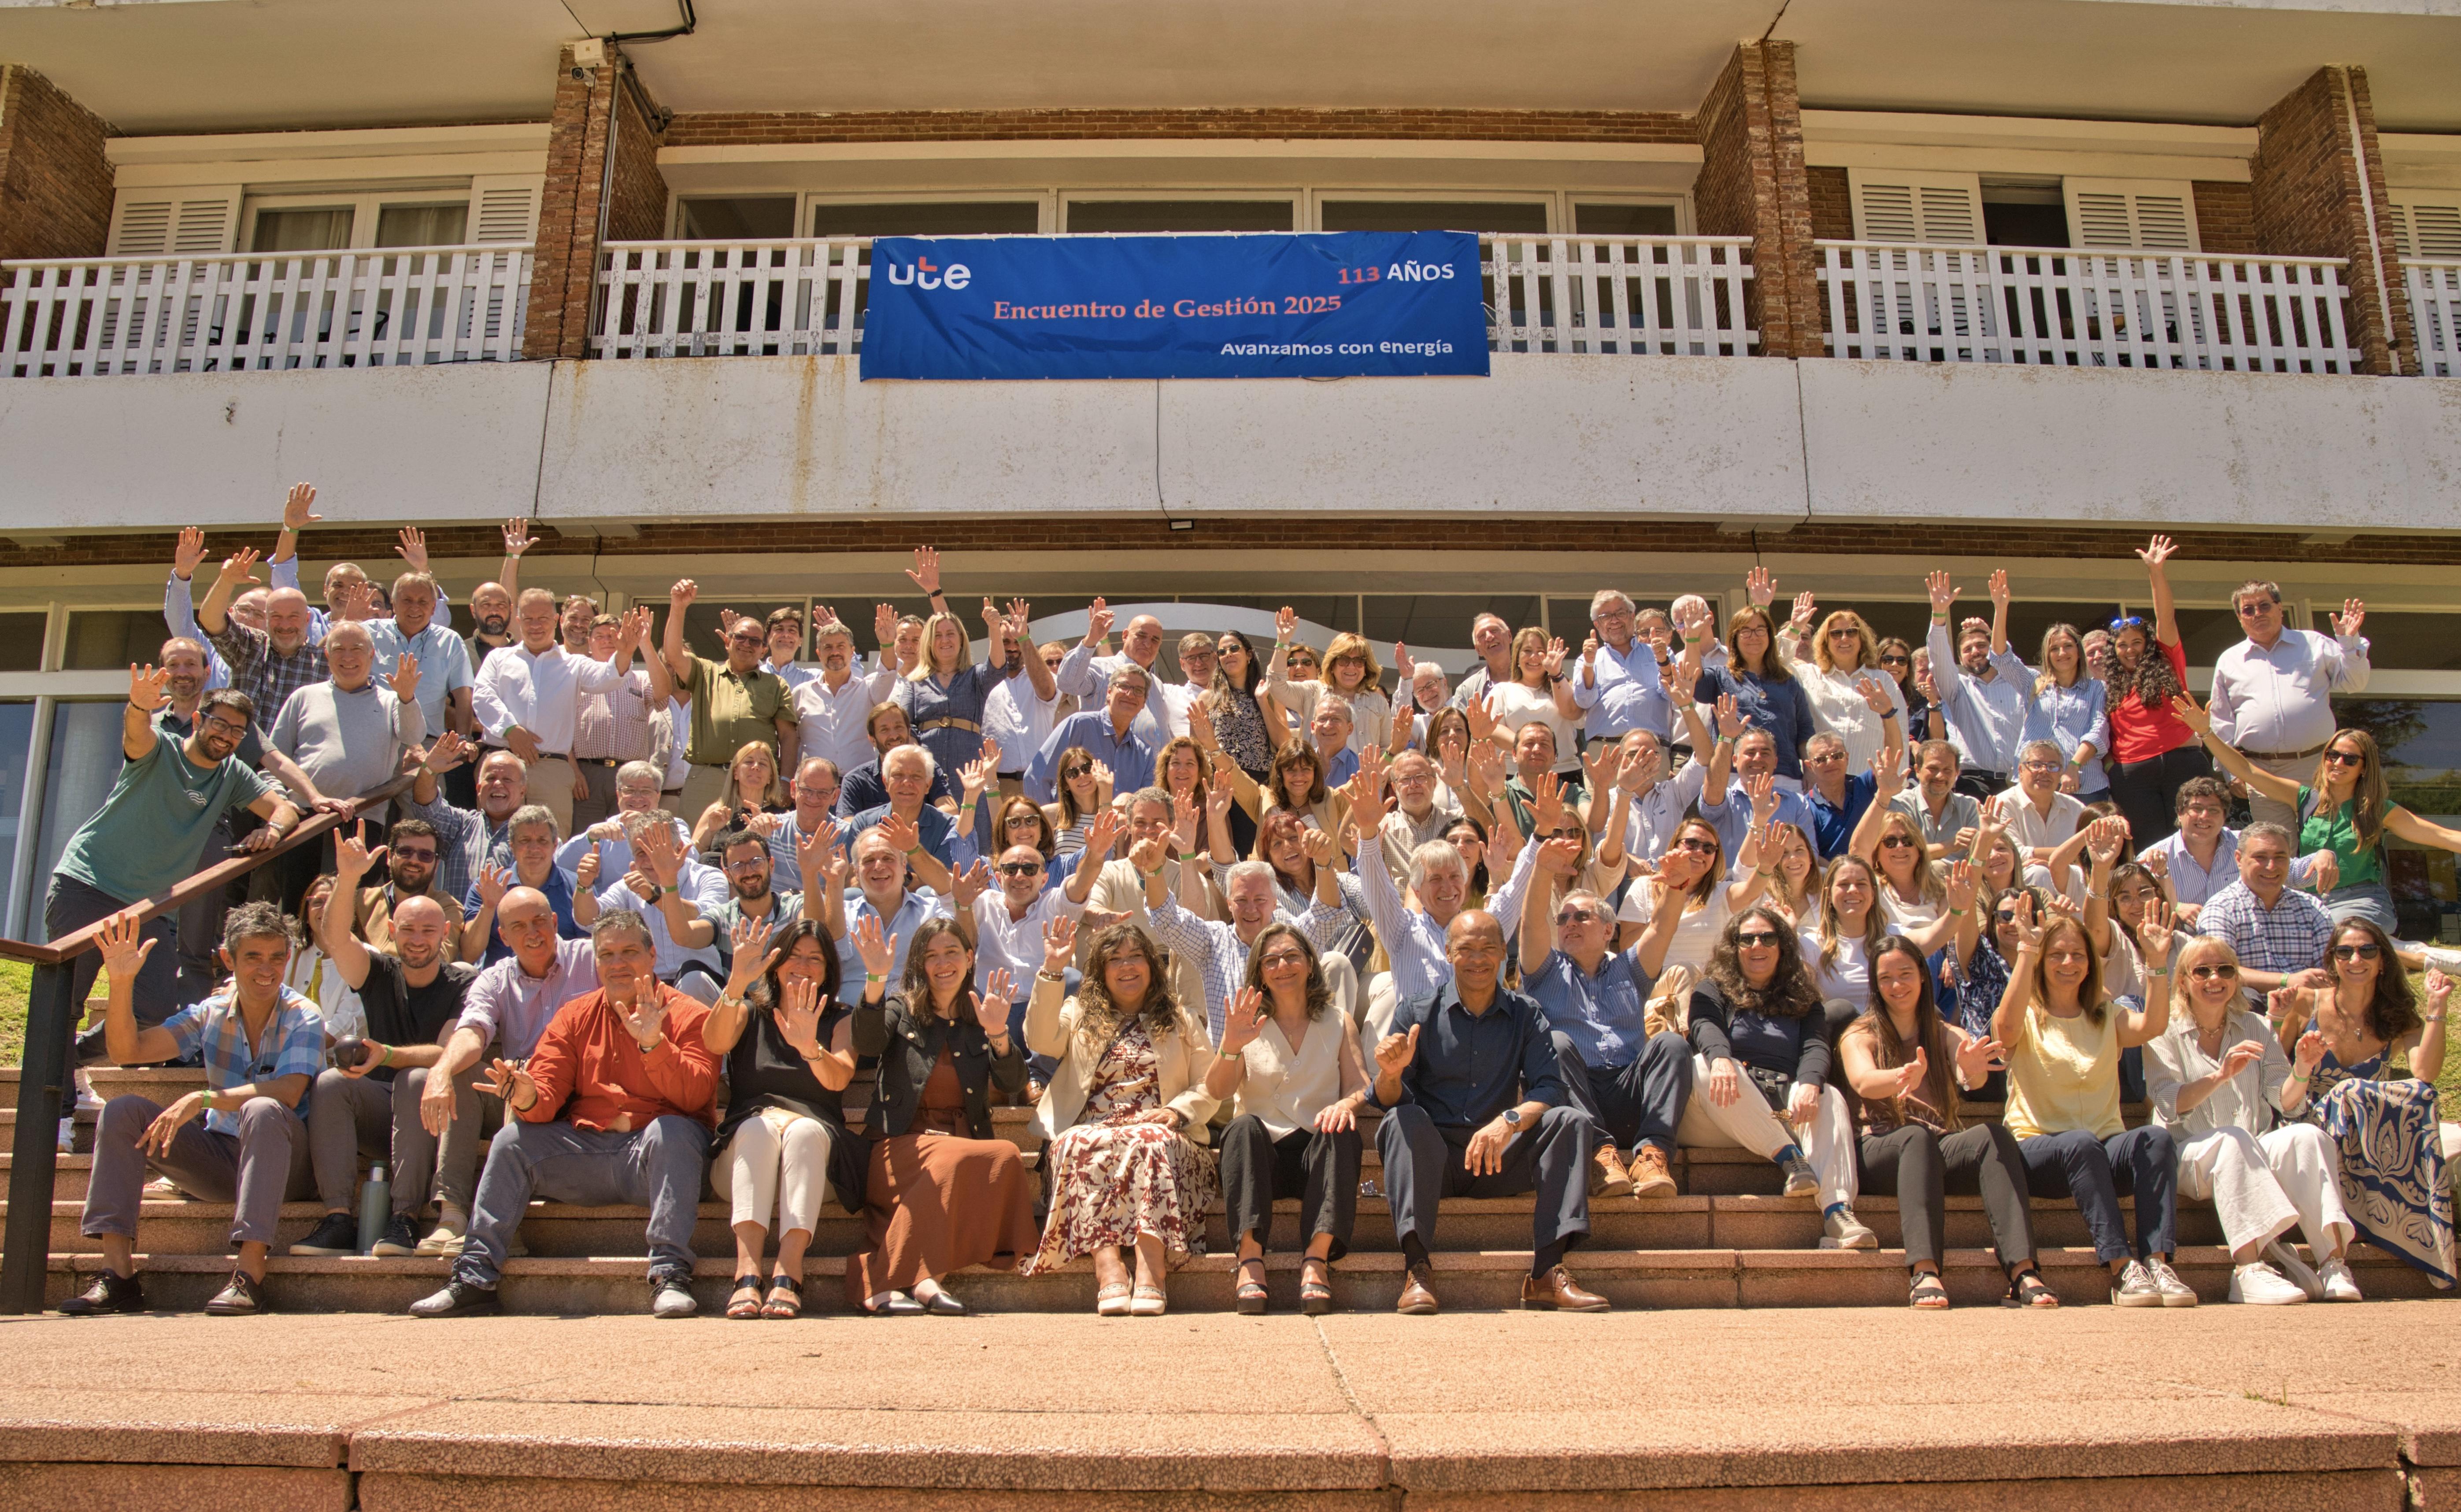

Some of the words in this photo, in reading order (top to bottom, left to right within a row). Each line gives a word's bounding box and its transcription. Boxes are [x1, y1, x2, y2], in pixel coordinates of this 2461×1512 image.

[1338, 266, 1380, 285] 113
[1387, 260, 1454, 281] AÑOS
[994, 300, 1126, 319] Encuentro
[1134, 299, 1165, 318] de
[1173, 296, 1276, 318] Gestión
[1284, 296, 1341, 314] 2025
[1221, 343, 1333, 355] Avanzamos
[1339, 344, 1373, 354] con
[1380, 340, 1453, 356] energía
